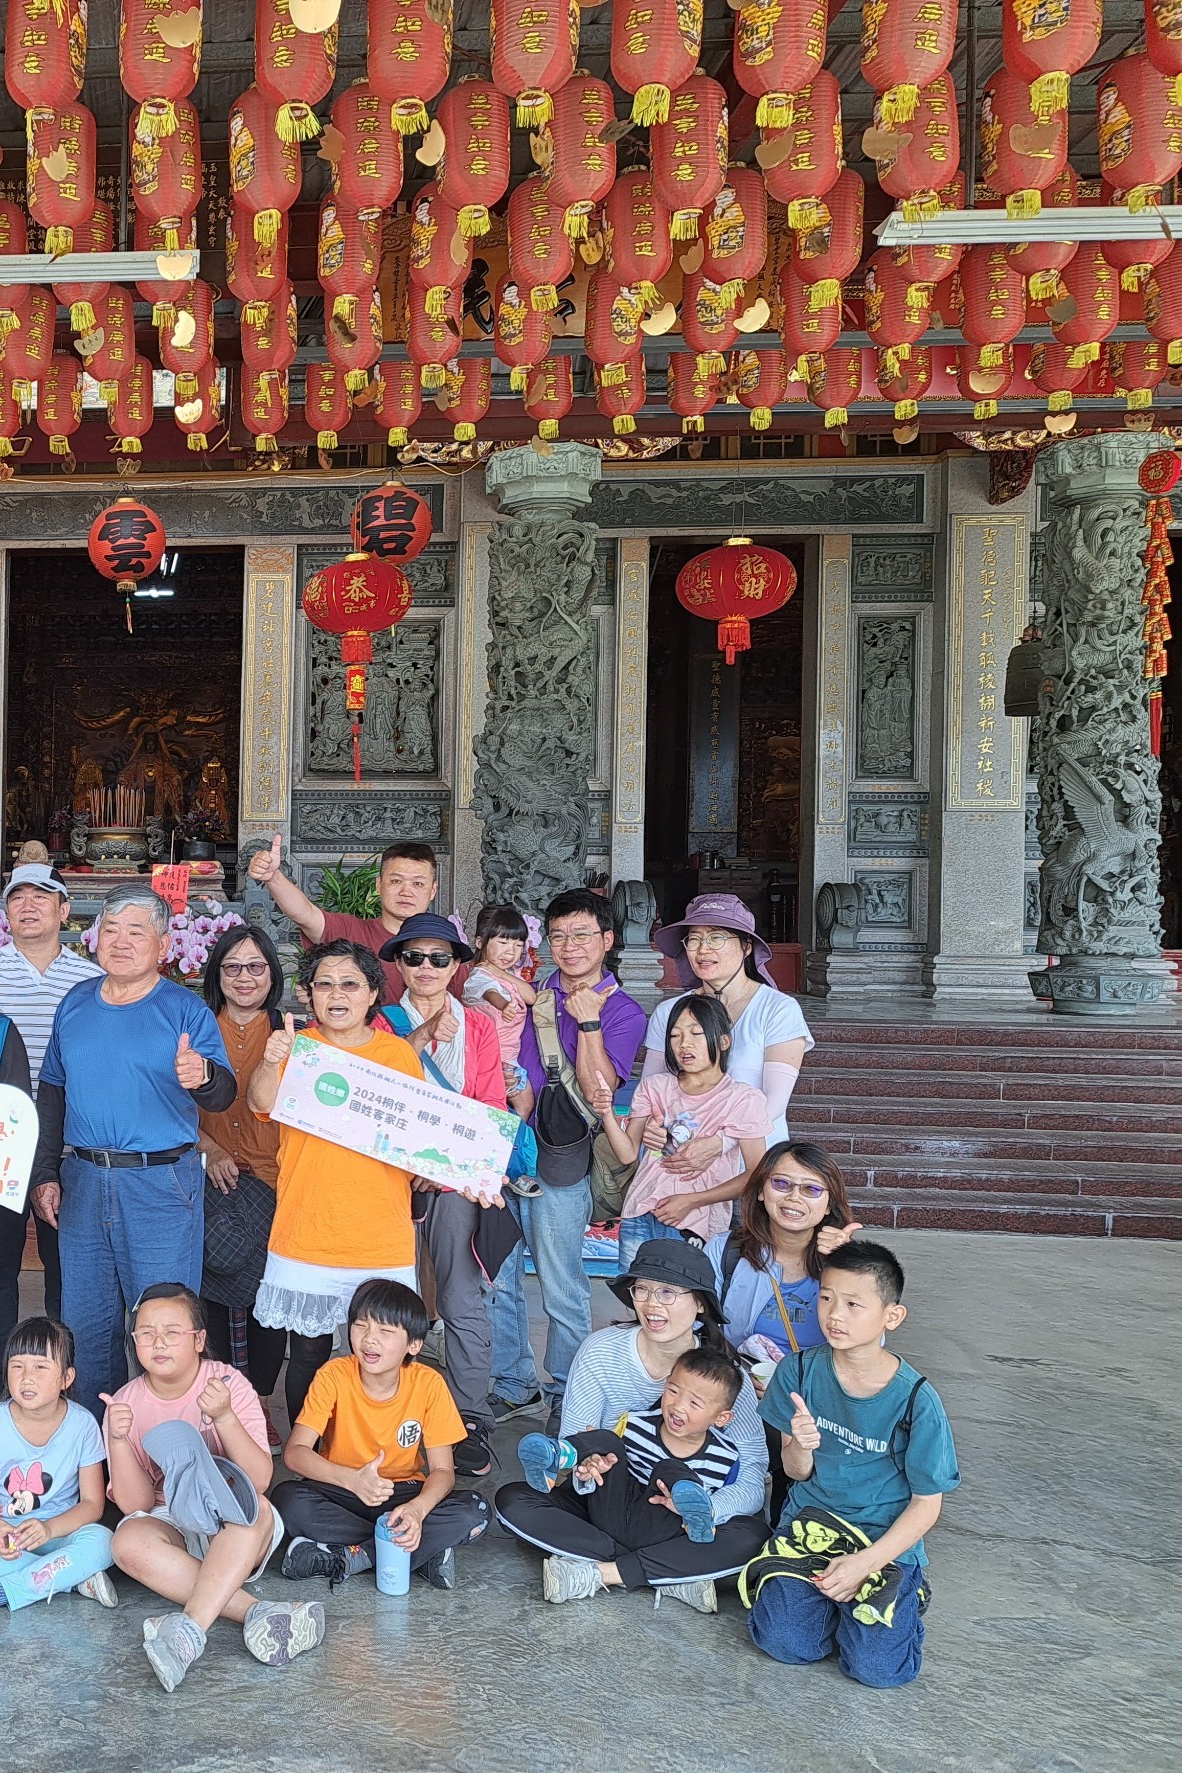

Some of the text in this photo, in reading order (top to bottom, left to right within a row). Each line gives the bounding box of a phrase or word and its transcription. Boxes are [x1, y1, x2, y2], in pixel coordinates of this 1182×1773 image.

[97, 510, 156, 574] 雲
[360, 490, 419, 556] 碧
[739, 553, 766, 600] 招財
[349, 1100, 410, 1131] 國姓客家庄
[400, 1420, 422, 1446] 悟
[817, 1415, 864, 1448] ADVENTURE
[865, 1437, 888, 1453] WILD
